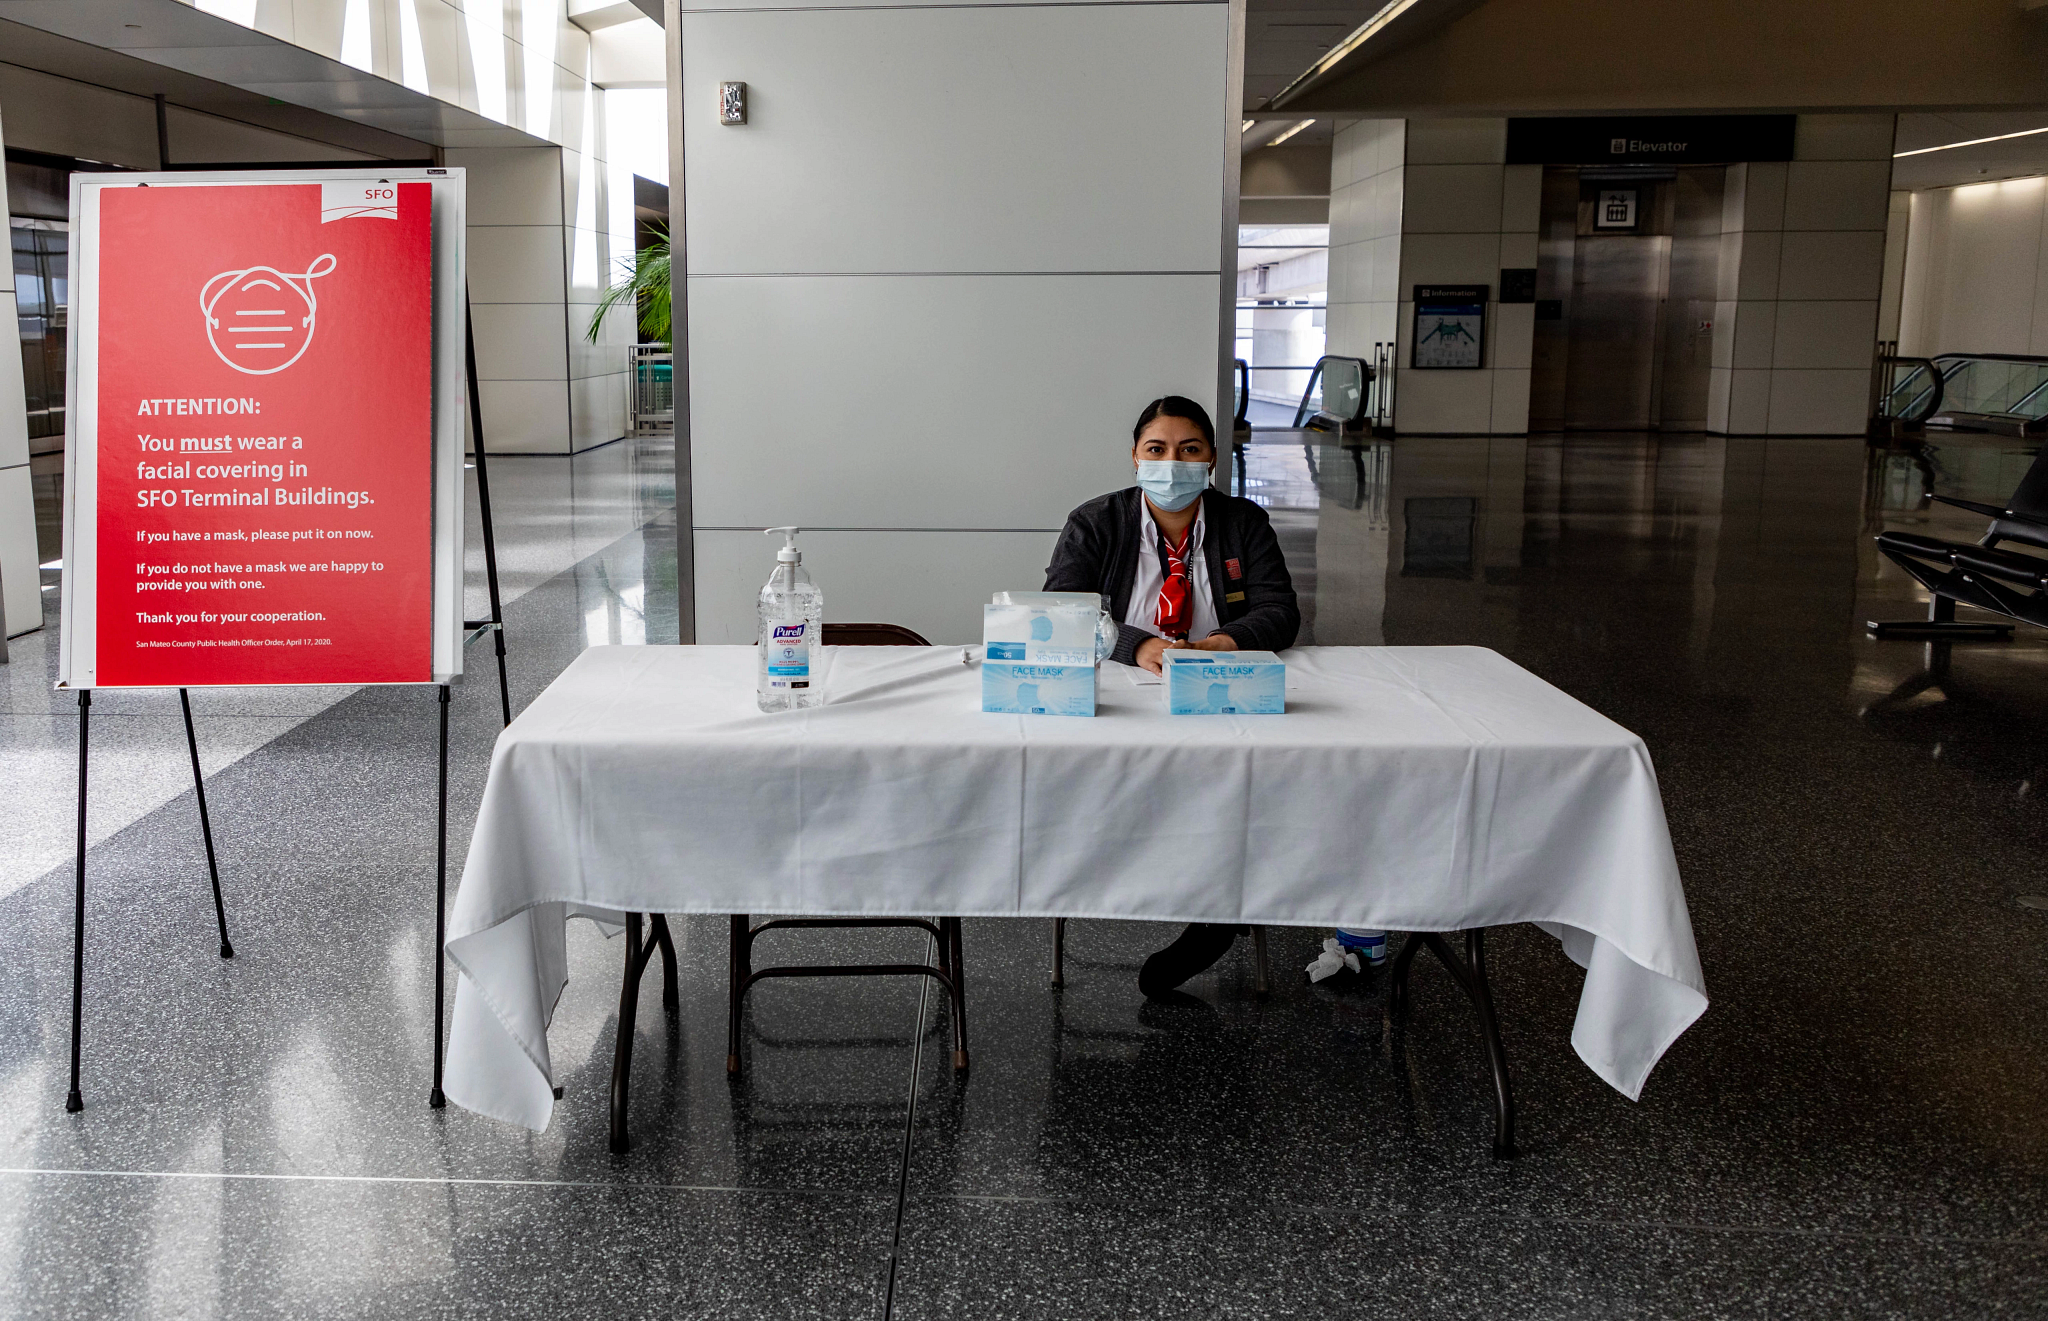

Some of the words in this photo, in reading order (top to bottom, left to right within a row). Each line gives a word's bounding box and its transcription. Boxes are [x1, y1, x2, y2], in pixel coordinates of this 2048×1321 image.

[1629, 140, 1688, 153] Elevator
[365, 189, 394, 199] SFO
[1431, 289, 1477, 297] Information
[138, 398, 260, 415] ATTENTION:
[138, 435, 174, 451] You
[180, 435, 232, 453] must
[237, 437, 286, 449] wear
[292, 437, 302, 449] a
[137, 461, 190, 479] facial
[196, 461, 283, 482] covering
[290, 460, 307, 477] in
[138, 490, 177, 507] SFO
[181, 488, 268, 506] Terminal
[276, 487, 374, 509] Buildings.
[137, 531, 146, 542] If
[148, 533, 170, 545] you
[173, 530, 202, 541] have
[204, 533, 211, 541] a
[214, 529, 249, 542] mask,
[252, 529, 290, 543] please
[293, 530, 314, 542] put
[316, 529, 325, 539] it
[327, 531, 343, 539] on
[346, 531, 374, 539] now.
[137, 563, 146, 575] If
[148, 566, 170, 577] you
[173, 563, 189, 574] do
[192, 564, 212, 574] not
[215, 562, 243, 574] have
[246, 565, 253, 573] a
[256, 562, 287, 573] mask
[290, 564, 307, 572] we
[310, 564, 329, 572] are
[332, 561, 369, 574] happy
[371, 562, 384, 571] to
[137, 579, 183, 594] provide
[185, 582, 208, 593] you
[210, 578, 237, 590] with
[240, 581, 266, 590] one.
[136, 612, 174, 624] Thank
[176, 615, 198, 626] you
[201, 611, 219, 623] for
[221, 614, 249, 625] your
[251, 610, 327, 624] cooperation.
[777, 626, 802, 637] Purell
[136, 640, 148, 648] San
[150, 640, 171, 648] Mateo
[172, 640, 196, 649] County
[197, 639, 217, 647] Public
[219, 639, 240, 647] Health
[241, 638, 263, 647] Officer
[265, 638, 285, 647] Order,
[286, 638, 301, 647] April
[304, 638, 313, 647] 17,
[315, 638, 332, 646] 2020.
[1036, 655, 1062, 663] MASK
[1064, 655, 1088, 663] FACE
[1012, 667, 1035, 676] FACE
[1038, 668, 1064, 676] MASK
[1202, 667, 1226, 676] FACE
[1229, 667, 1254, 675] MASK
